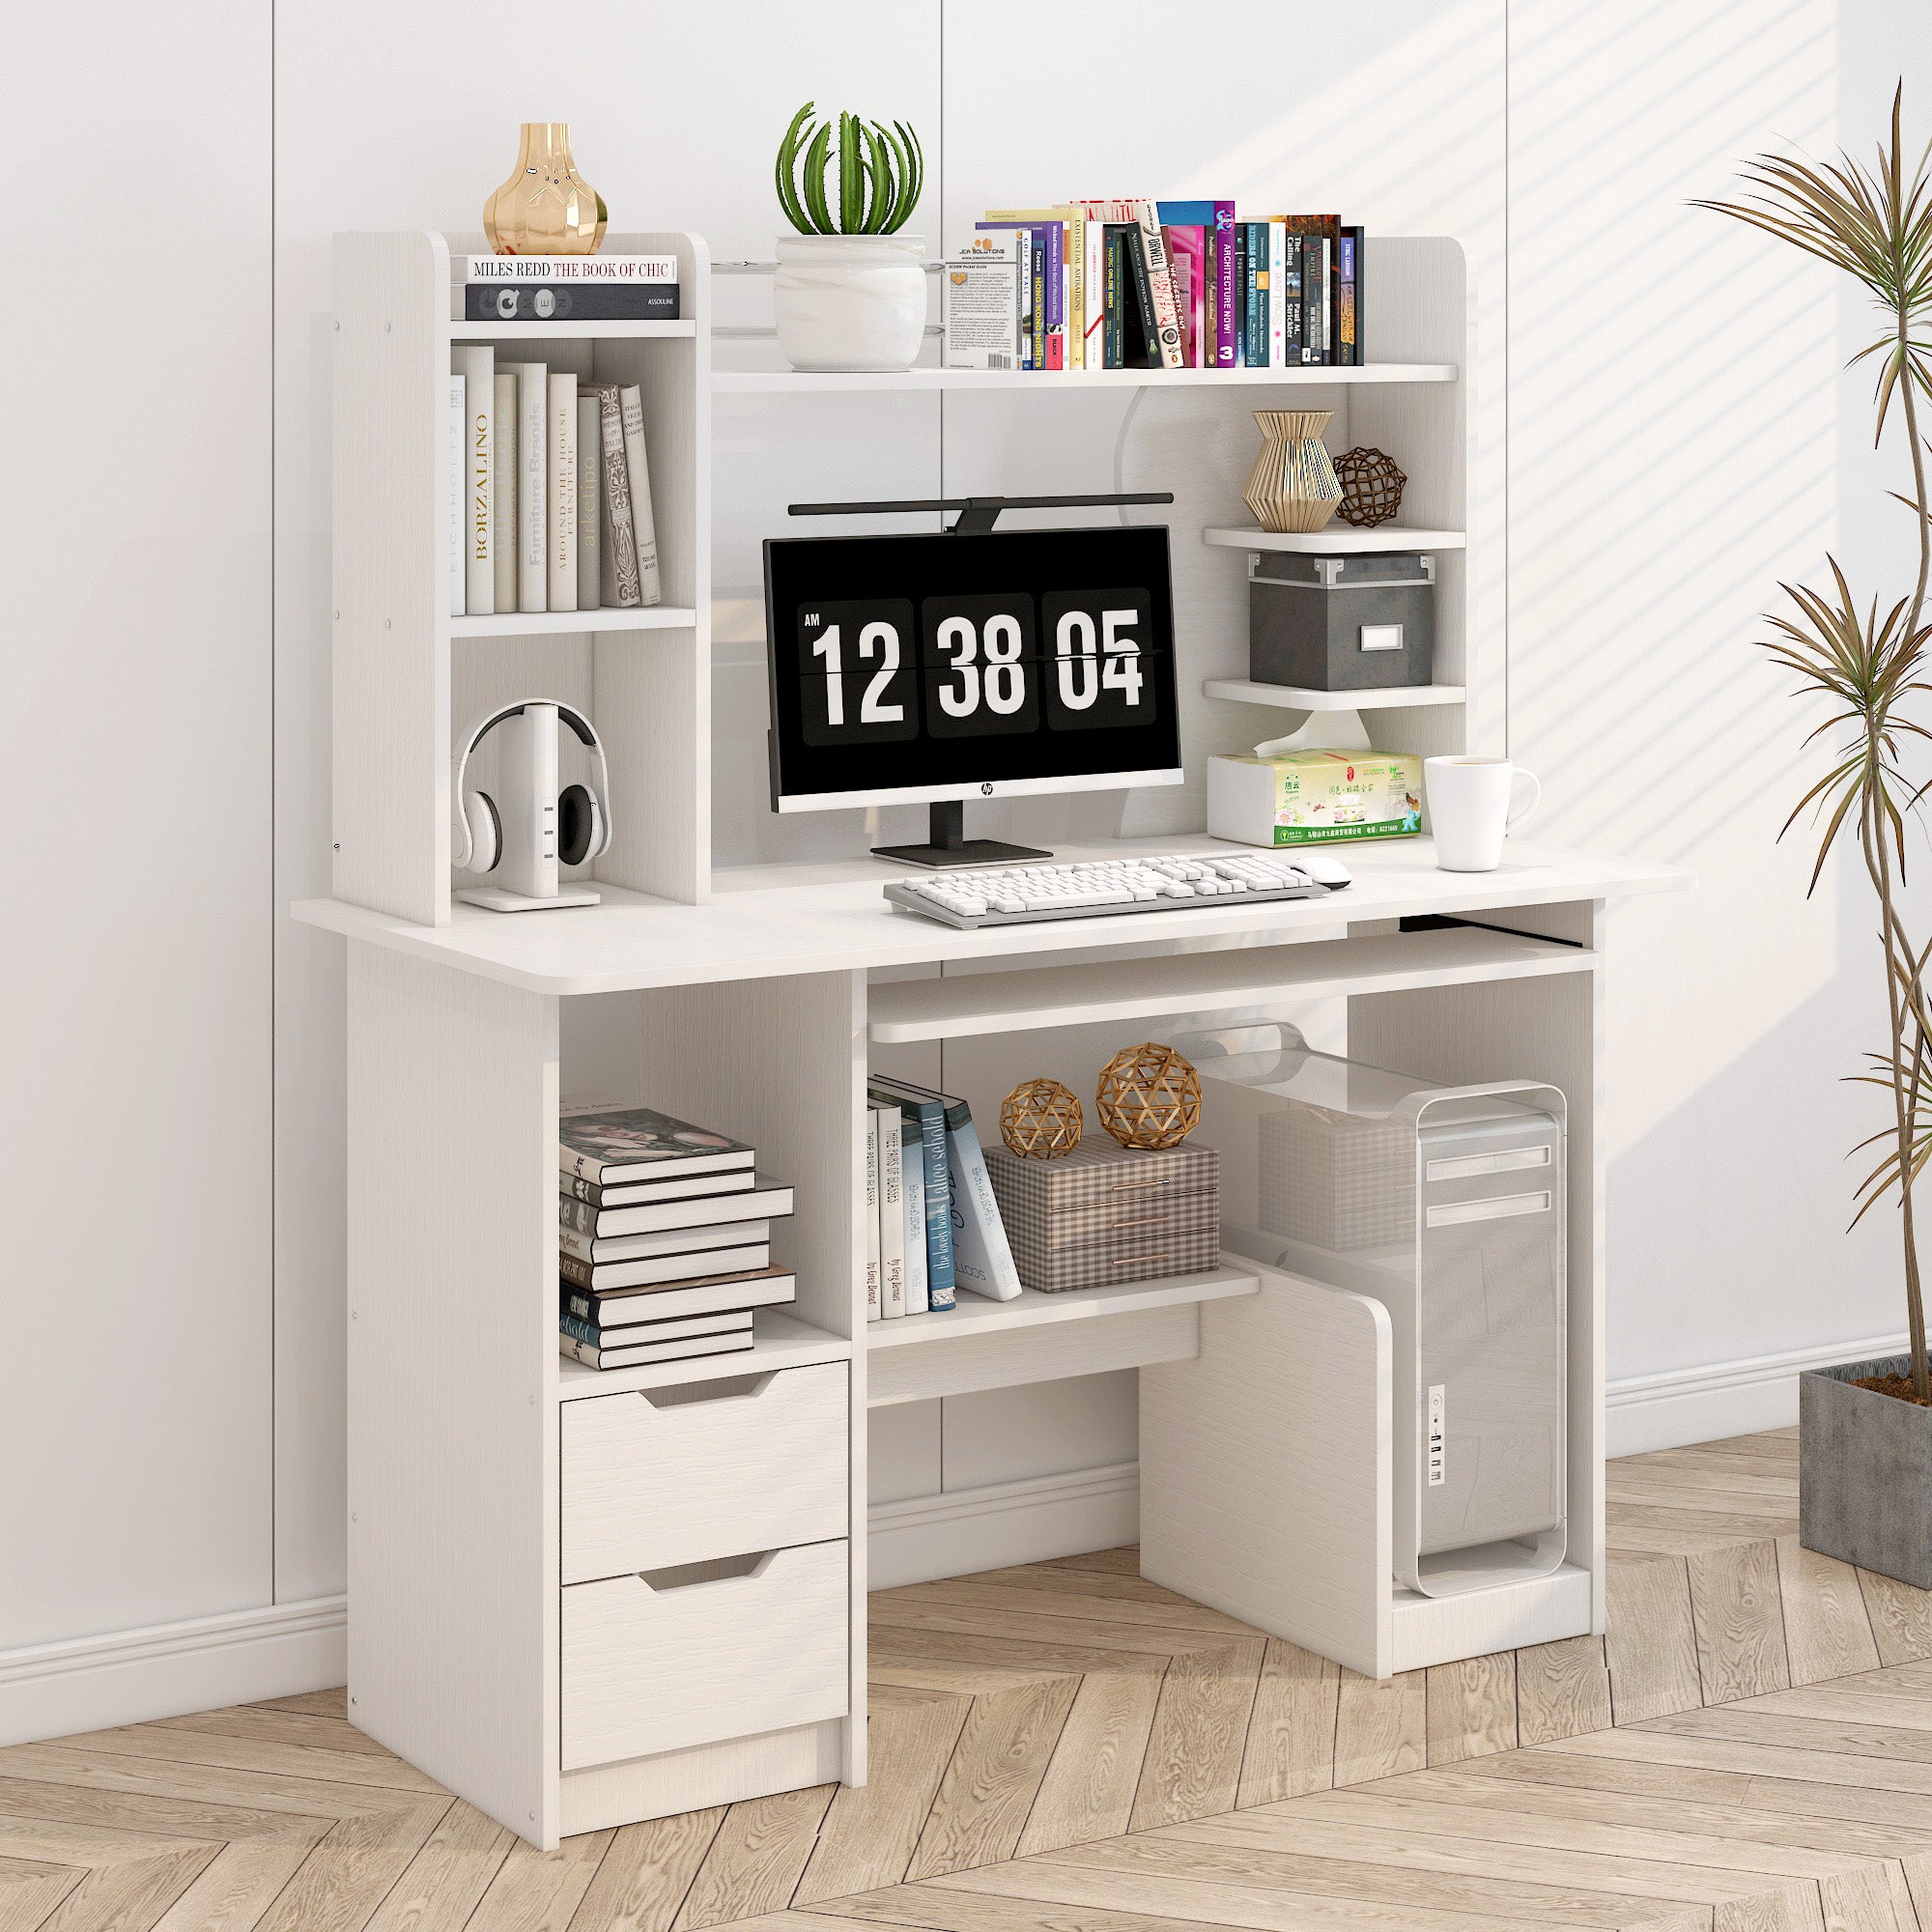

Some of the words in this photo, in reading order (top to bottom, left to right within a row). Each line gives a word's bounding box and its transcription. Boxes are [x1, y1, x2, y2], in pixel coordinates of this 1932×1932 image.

[1149, 239, 1164, 267] ORWELL
[1248, 257, 1256, 269] ON
[1312, 244, 1321, 283] VAMPIRE
[473, 263, 513, 276] MILES
[516, 263, 551, 276] REDD
[554, 263, 579, 277] THE
[582, 263, 616, 277] BOOK
[619, 263, 636, 277] OF
[639, 263, 668, 277] CHIC
[1024, 263, 1029, 271] AT
[1223, 243, 1232, 309] ARCHITECTURE
[1272, 272, 1283, 298] Love
[1172, 279, 1182, 313] SECRETS
[1177, 316, 1185, 329] OUT
[1272, 301, 1283, 327] Slow
[1223, 311, 1232, 334] NOW!
[1294, 324, 1300, 334] M.
[1035, 333, 1043, 368] NIGHTS
[529, 403, 542, 472] Brands
[475, 413, 488, 560] BORZALINO
[582, 457, 595, 546] arketipo
[529, 477, 542, 565] Furniture
[804, 613, 819, 627] AM
[812, 621, 904, 726] 12
[936, 614, 1026, 718] 38
[981, 782, 993, 795] hp
[886, 1129, 898, 1149] THREE
[922, 1115, 945, 1159] sebold
[886, 1150, 898, 1166] PAIRS
[925, 1164, 948, 1194] alice
[972, 1166, 985, 1185] FATHER
[886, 1177, 898, 1204] GLASSES
[930, 1205, 949, 1231] bones
[980, 1199, 994, 1215] GHOST
[931, 1231, 951, 1255] lovely
[887, 1267, 900, 1282] Greg
[934, 1255, 951, 1269] the
[867, 1270, 877, 1284] Greg
[867, 1285, 877, 1304] Bennet
[892, 1282, 901, 1301] Bennet
[559, 1316, 589, 1343] ebold
